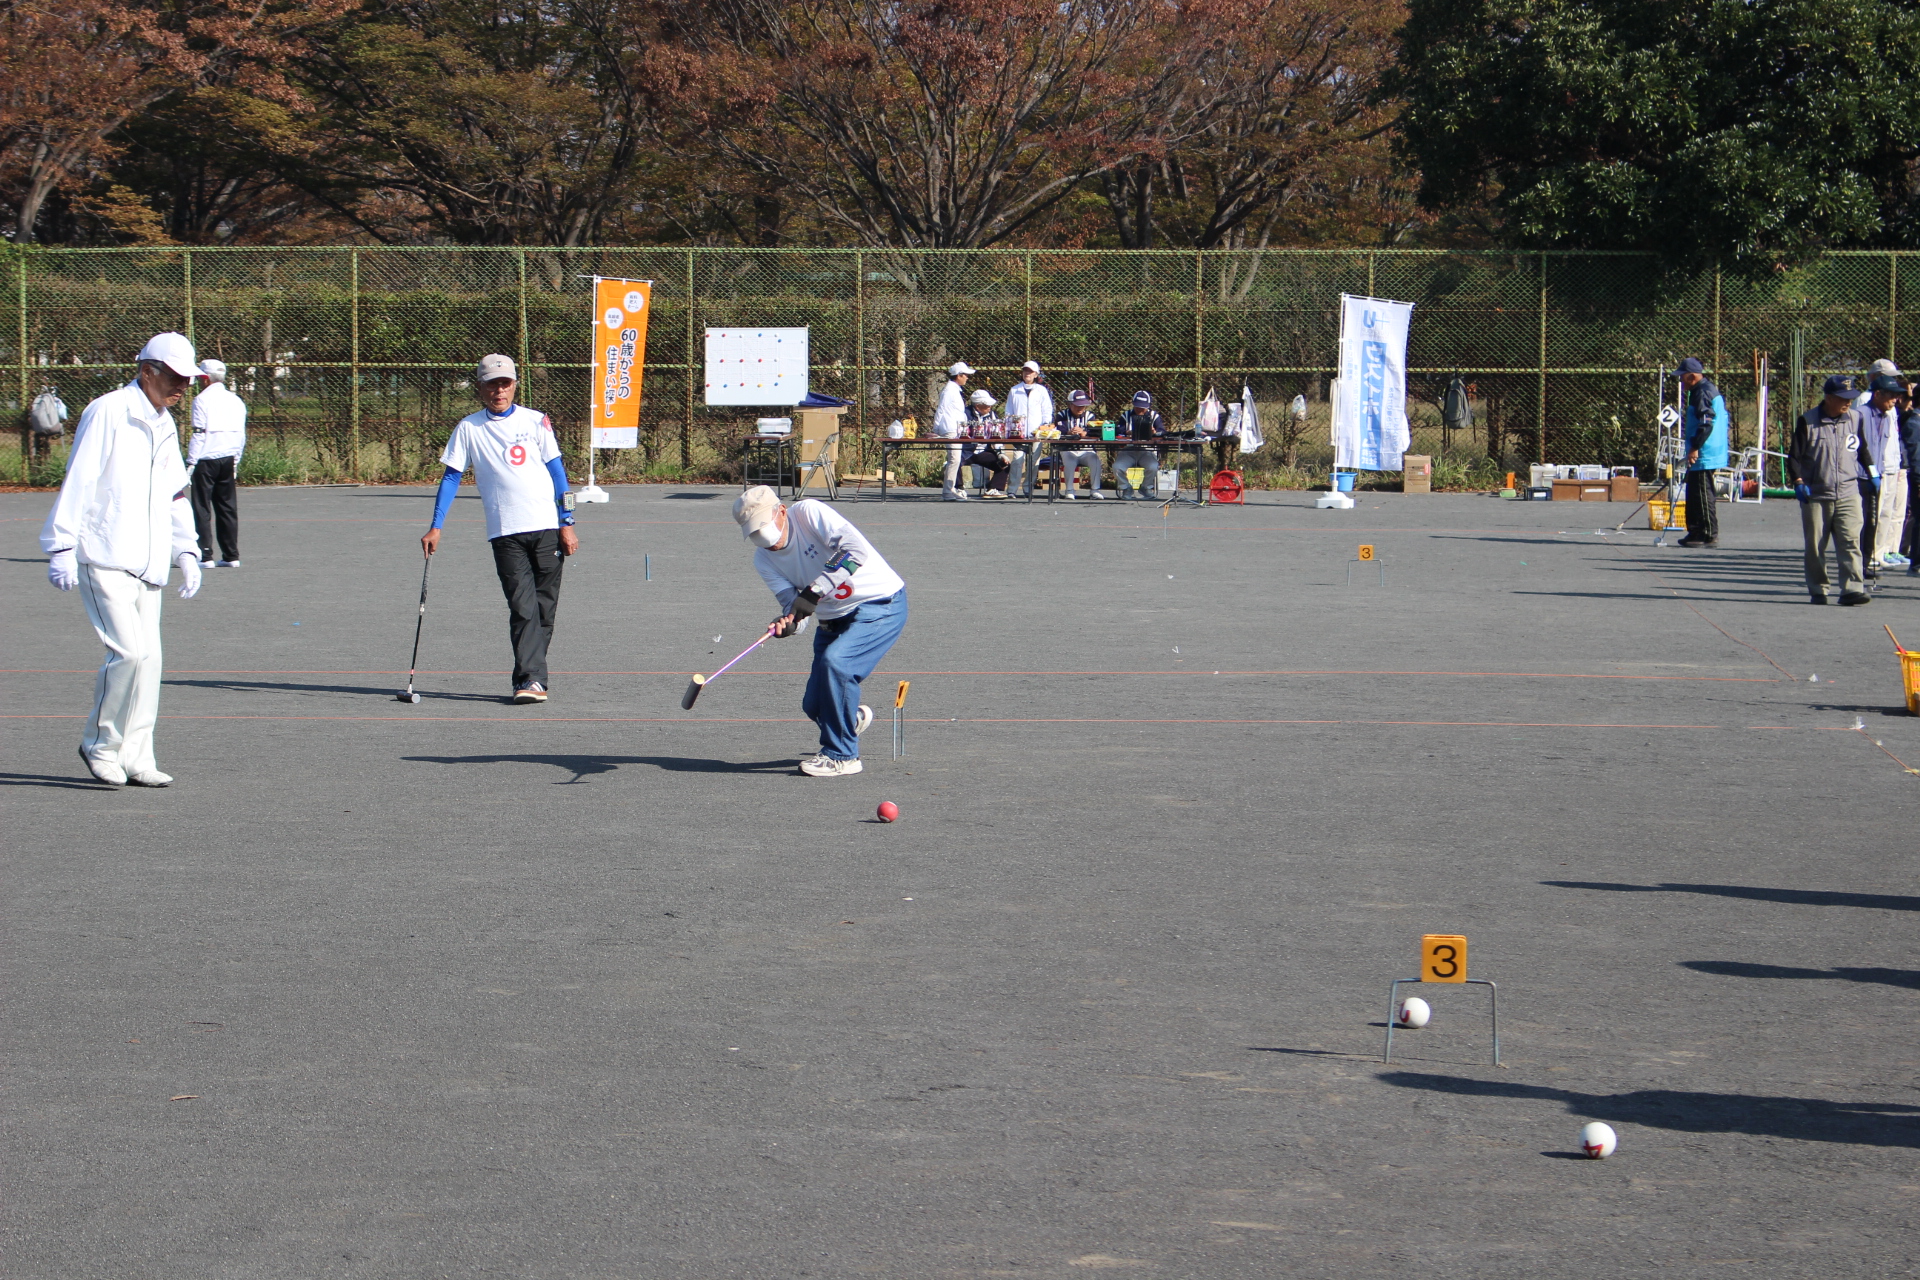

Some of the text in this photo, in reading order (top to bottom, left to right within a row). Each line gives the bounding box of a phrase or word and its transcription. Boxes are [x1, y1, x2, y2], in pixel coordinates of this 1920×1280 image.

[618, 329, 637, 398] 60歳からの
[605, 346, 618, 418] 住まい探し
[1662, 409, 1673, 423] 2
[1846, 435, 1857, 450] 2
[509, 445, 526, 466] 9
[1361, 547, 1371, 559] 3
[1431, 944, 1459, 978] 3
